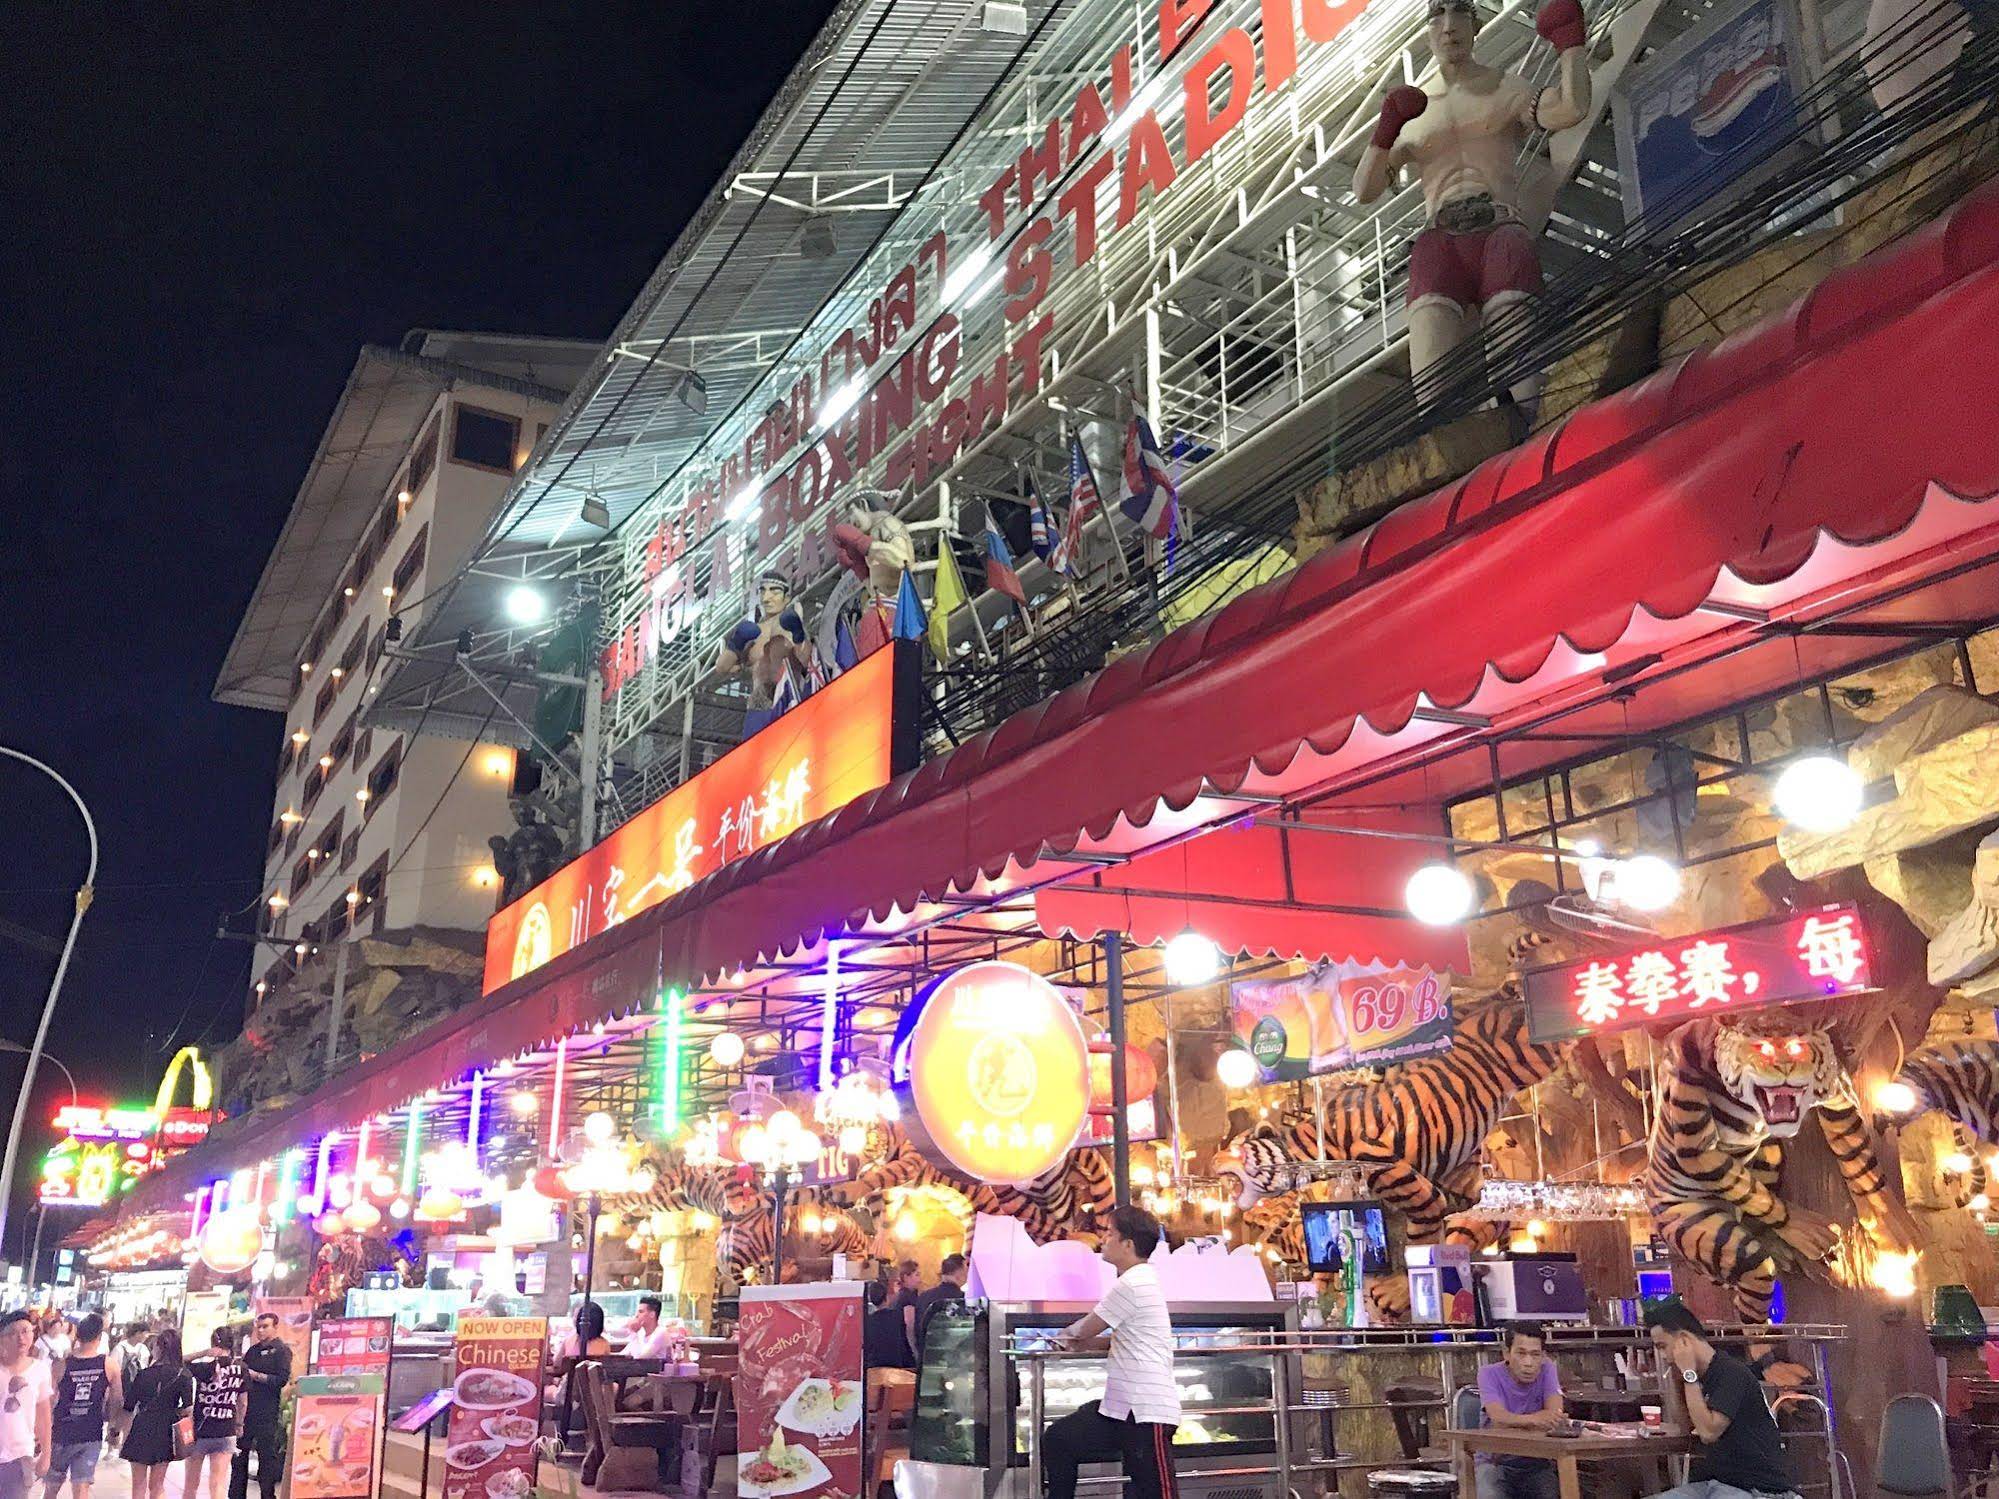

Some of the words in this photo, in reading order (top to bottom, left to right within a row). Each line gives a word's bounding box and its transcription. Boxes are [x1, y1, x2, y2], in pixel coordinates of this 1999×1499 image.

[979, 43, 1132, 241] THAI
[886, 313, 1054, 489] FIGHT
[599, 534, 732, 703] BANGLA
[759, 314, 963, 562] BOXING
[1797, 914, 1867, 983] 每
[1352, 982, 1406, 1035] 69
[1253, 1038, 1284, 1055] Chang
[463, 1321, 499, 1335] NOW
[502, 1321, 542, 1334] OPEN
[740, 1301, 774, 1331] Crab
[458, 1343, 541, 1365] Chinese
[757, 1323, 808, 1363] Festival
